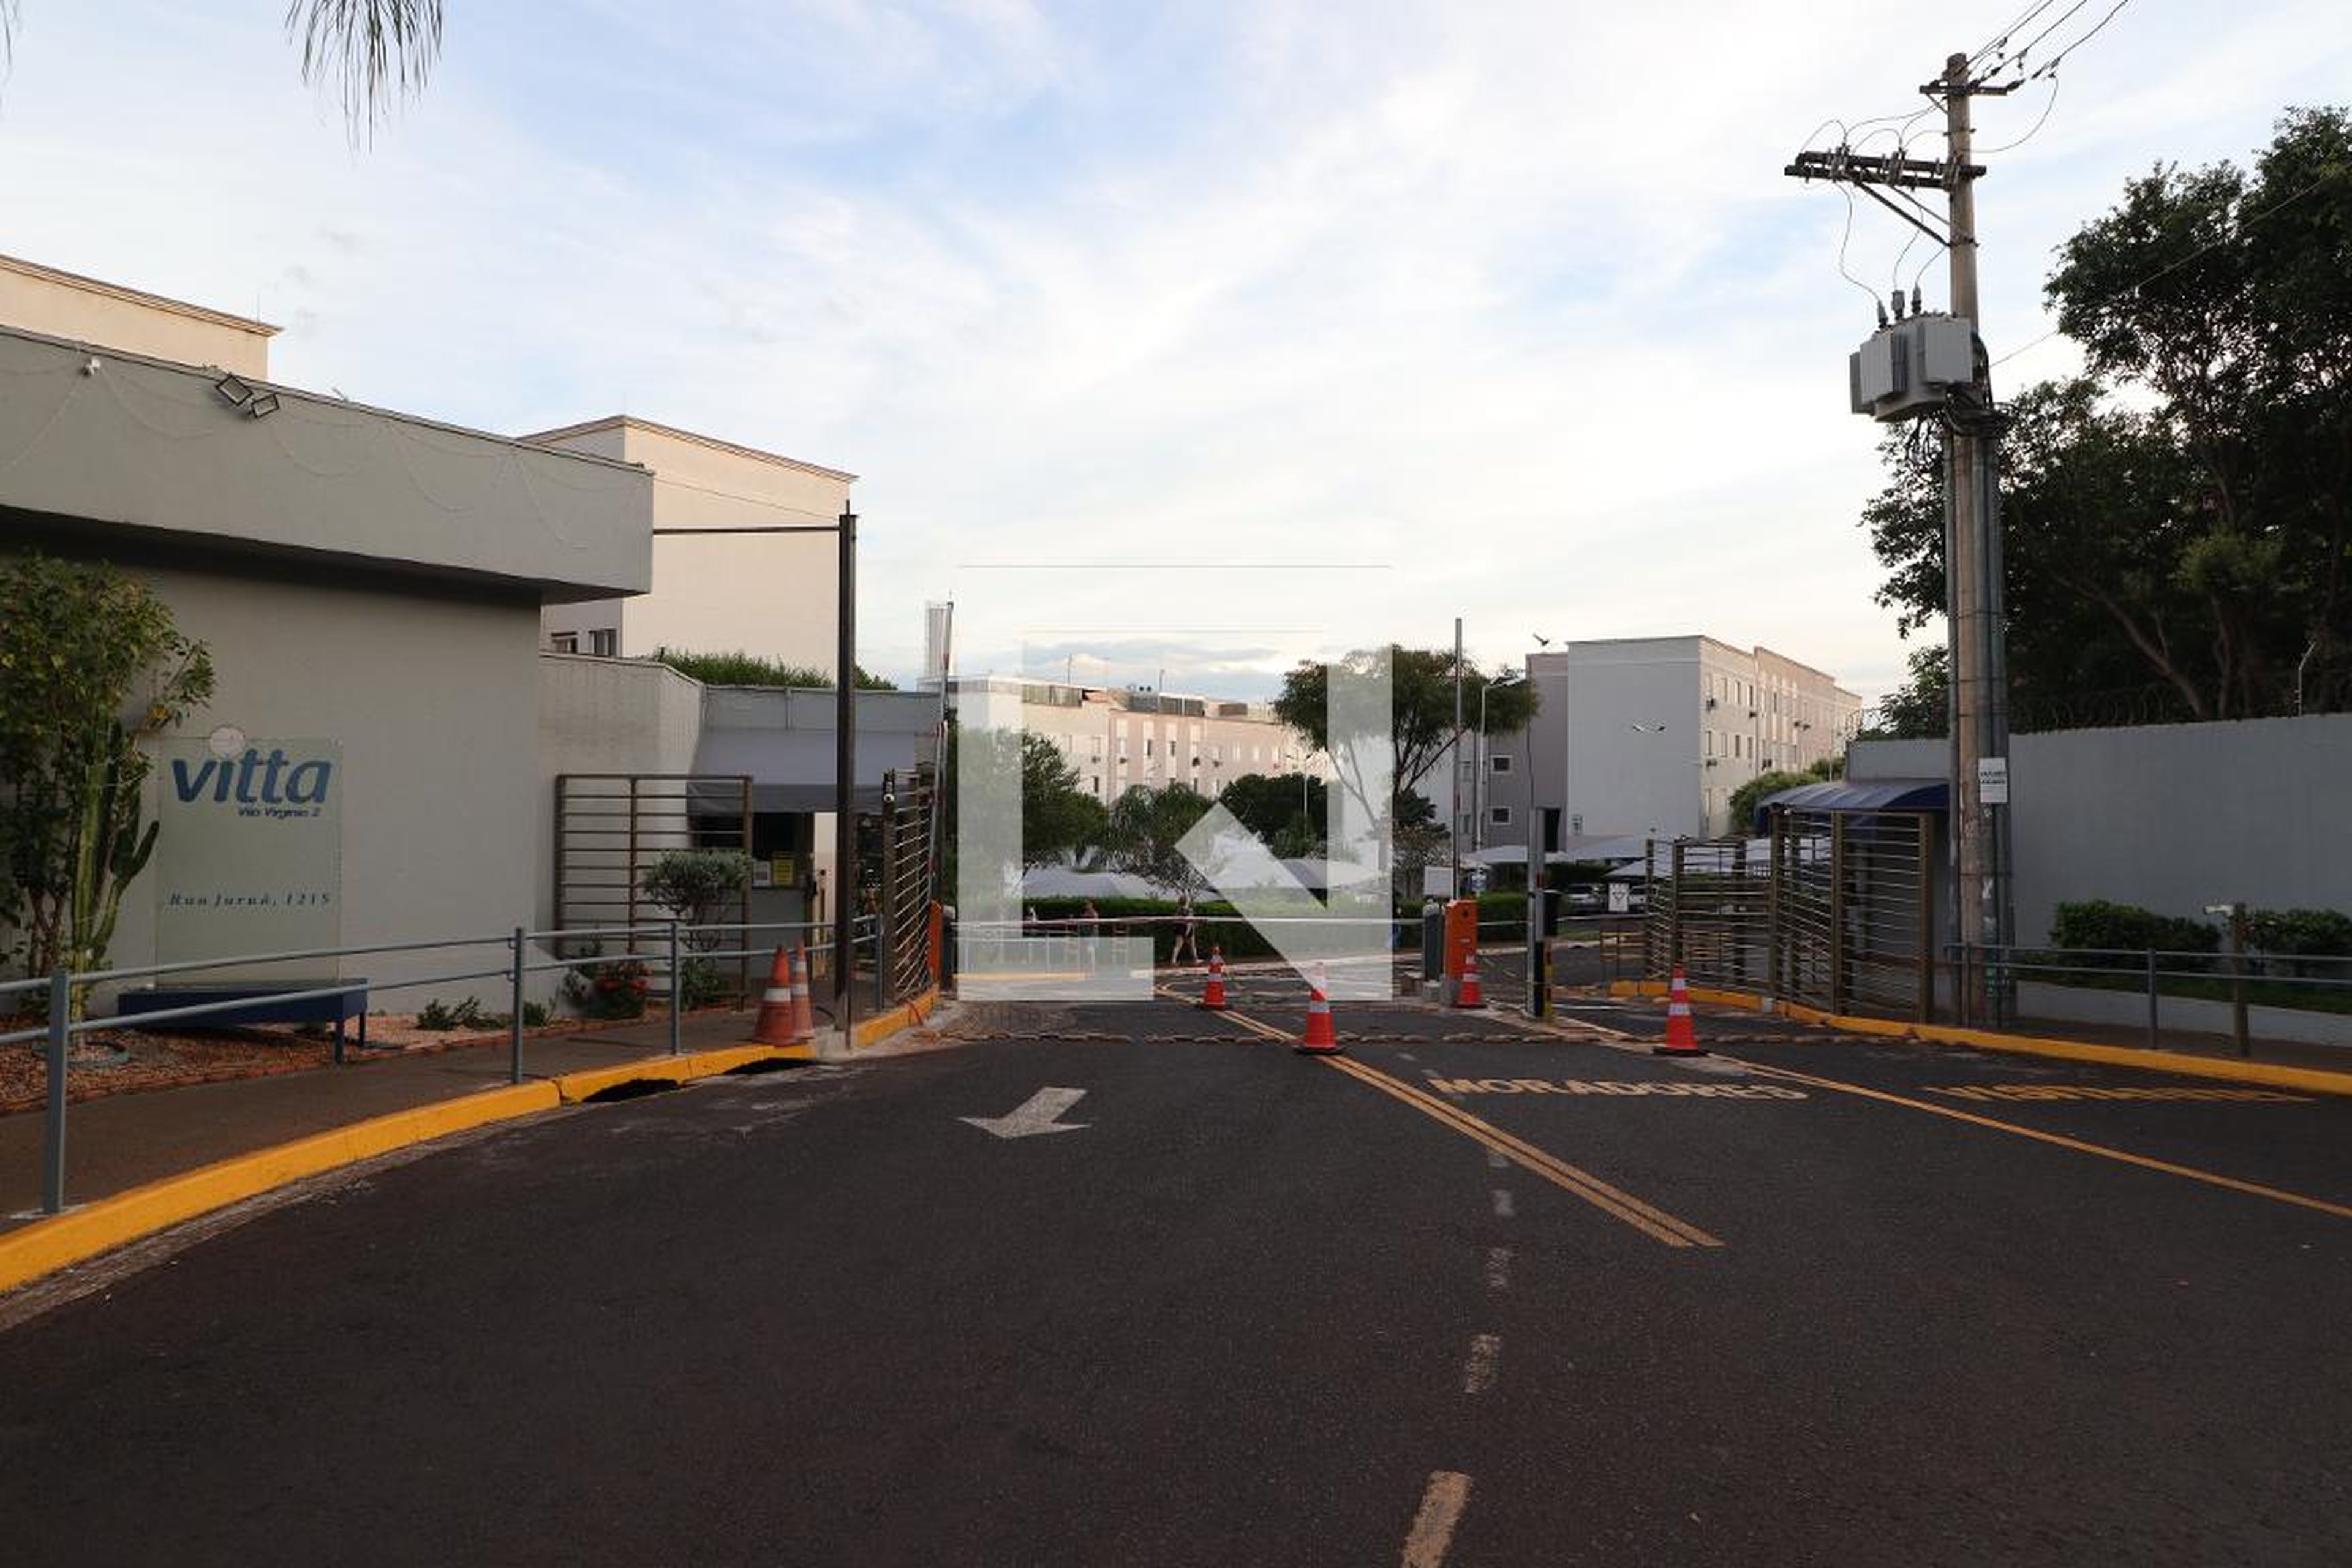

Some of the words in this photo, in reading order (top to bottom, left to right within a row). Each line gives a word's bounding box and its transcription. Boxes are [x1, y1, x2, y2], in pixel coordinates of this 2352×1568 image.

[172, 726, 333, 804] vitta
[170, 892, 208, 907] Rua
[286, 892, 331, 906] 1215
[1428, 1078, 1809, 1099] MORADORES
